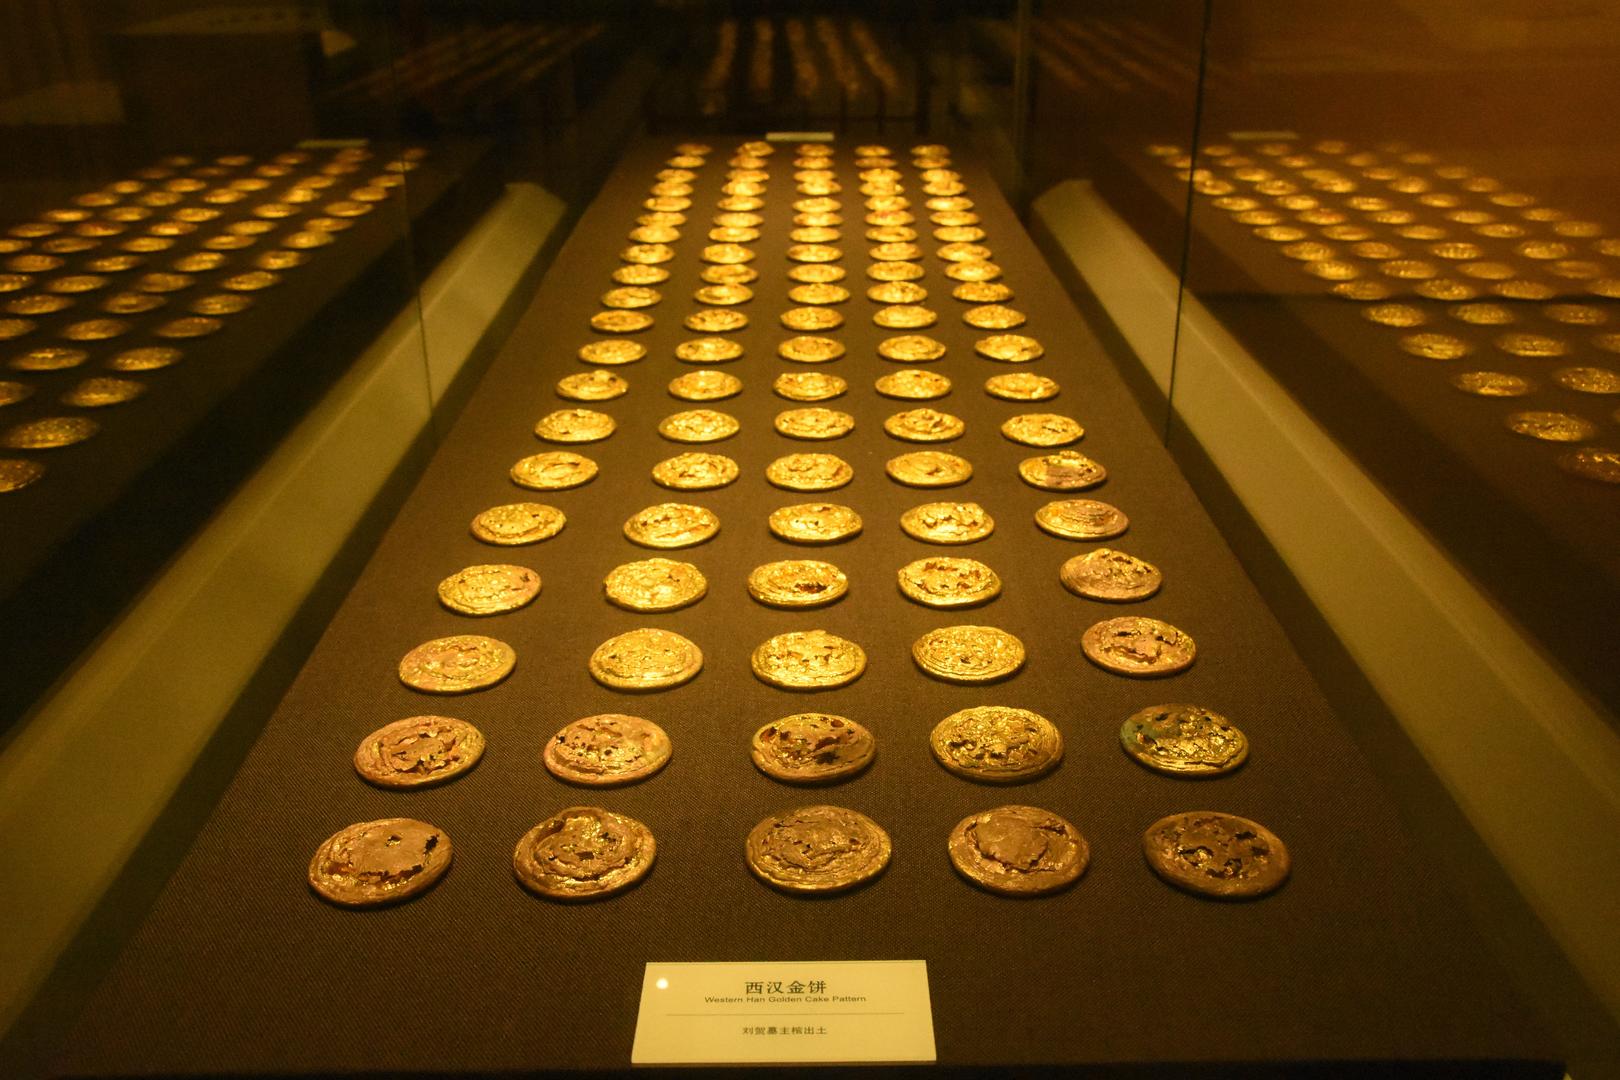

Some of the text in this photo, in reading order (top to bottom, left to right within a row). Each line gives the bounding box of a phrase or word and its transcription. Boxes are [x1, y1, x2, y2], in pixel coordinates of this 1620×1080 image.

[744, 980, 827, 995] 西汉金饼
[704, 994, 867, 1004] Western Han Golden Cake Pattern
